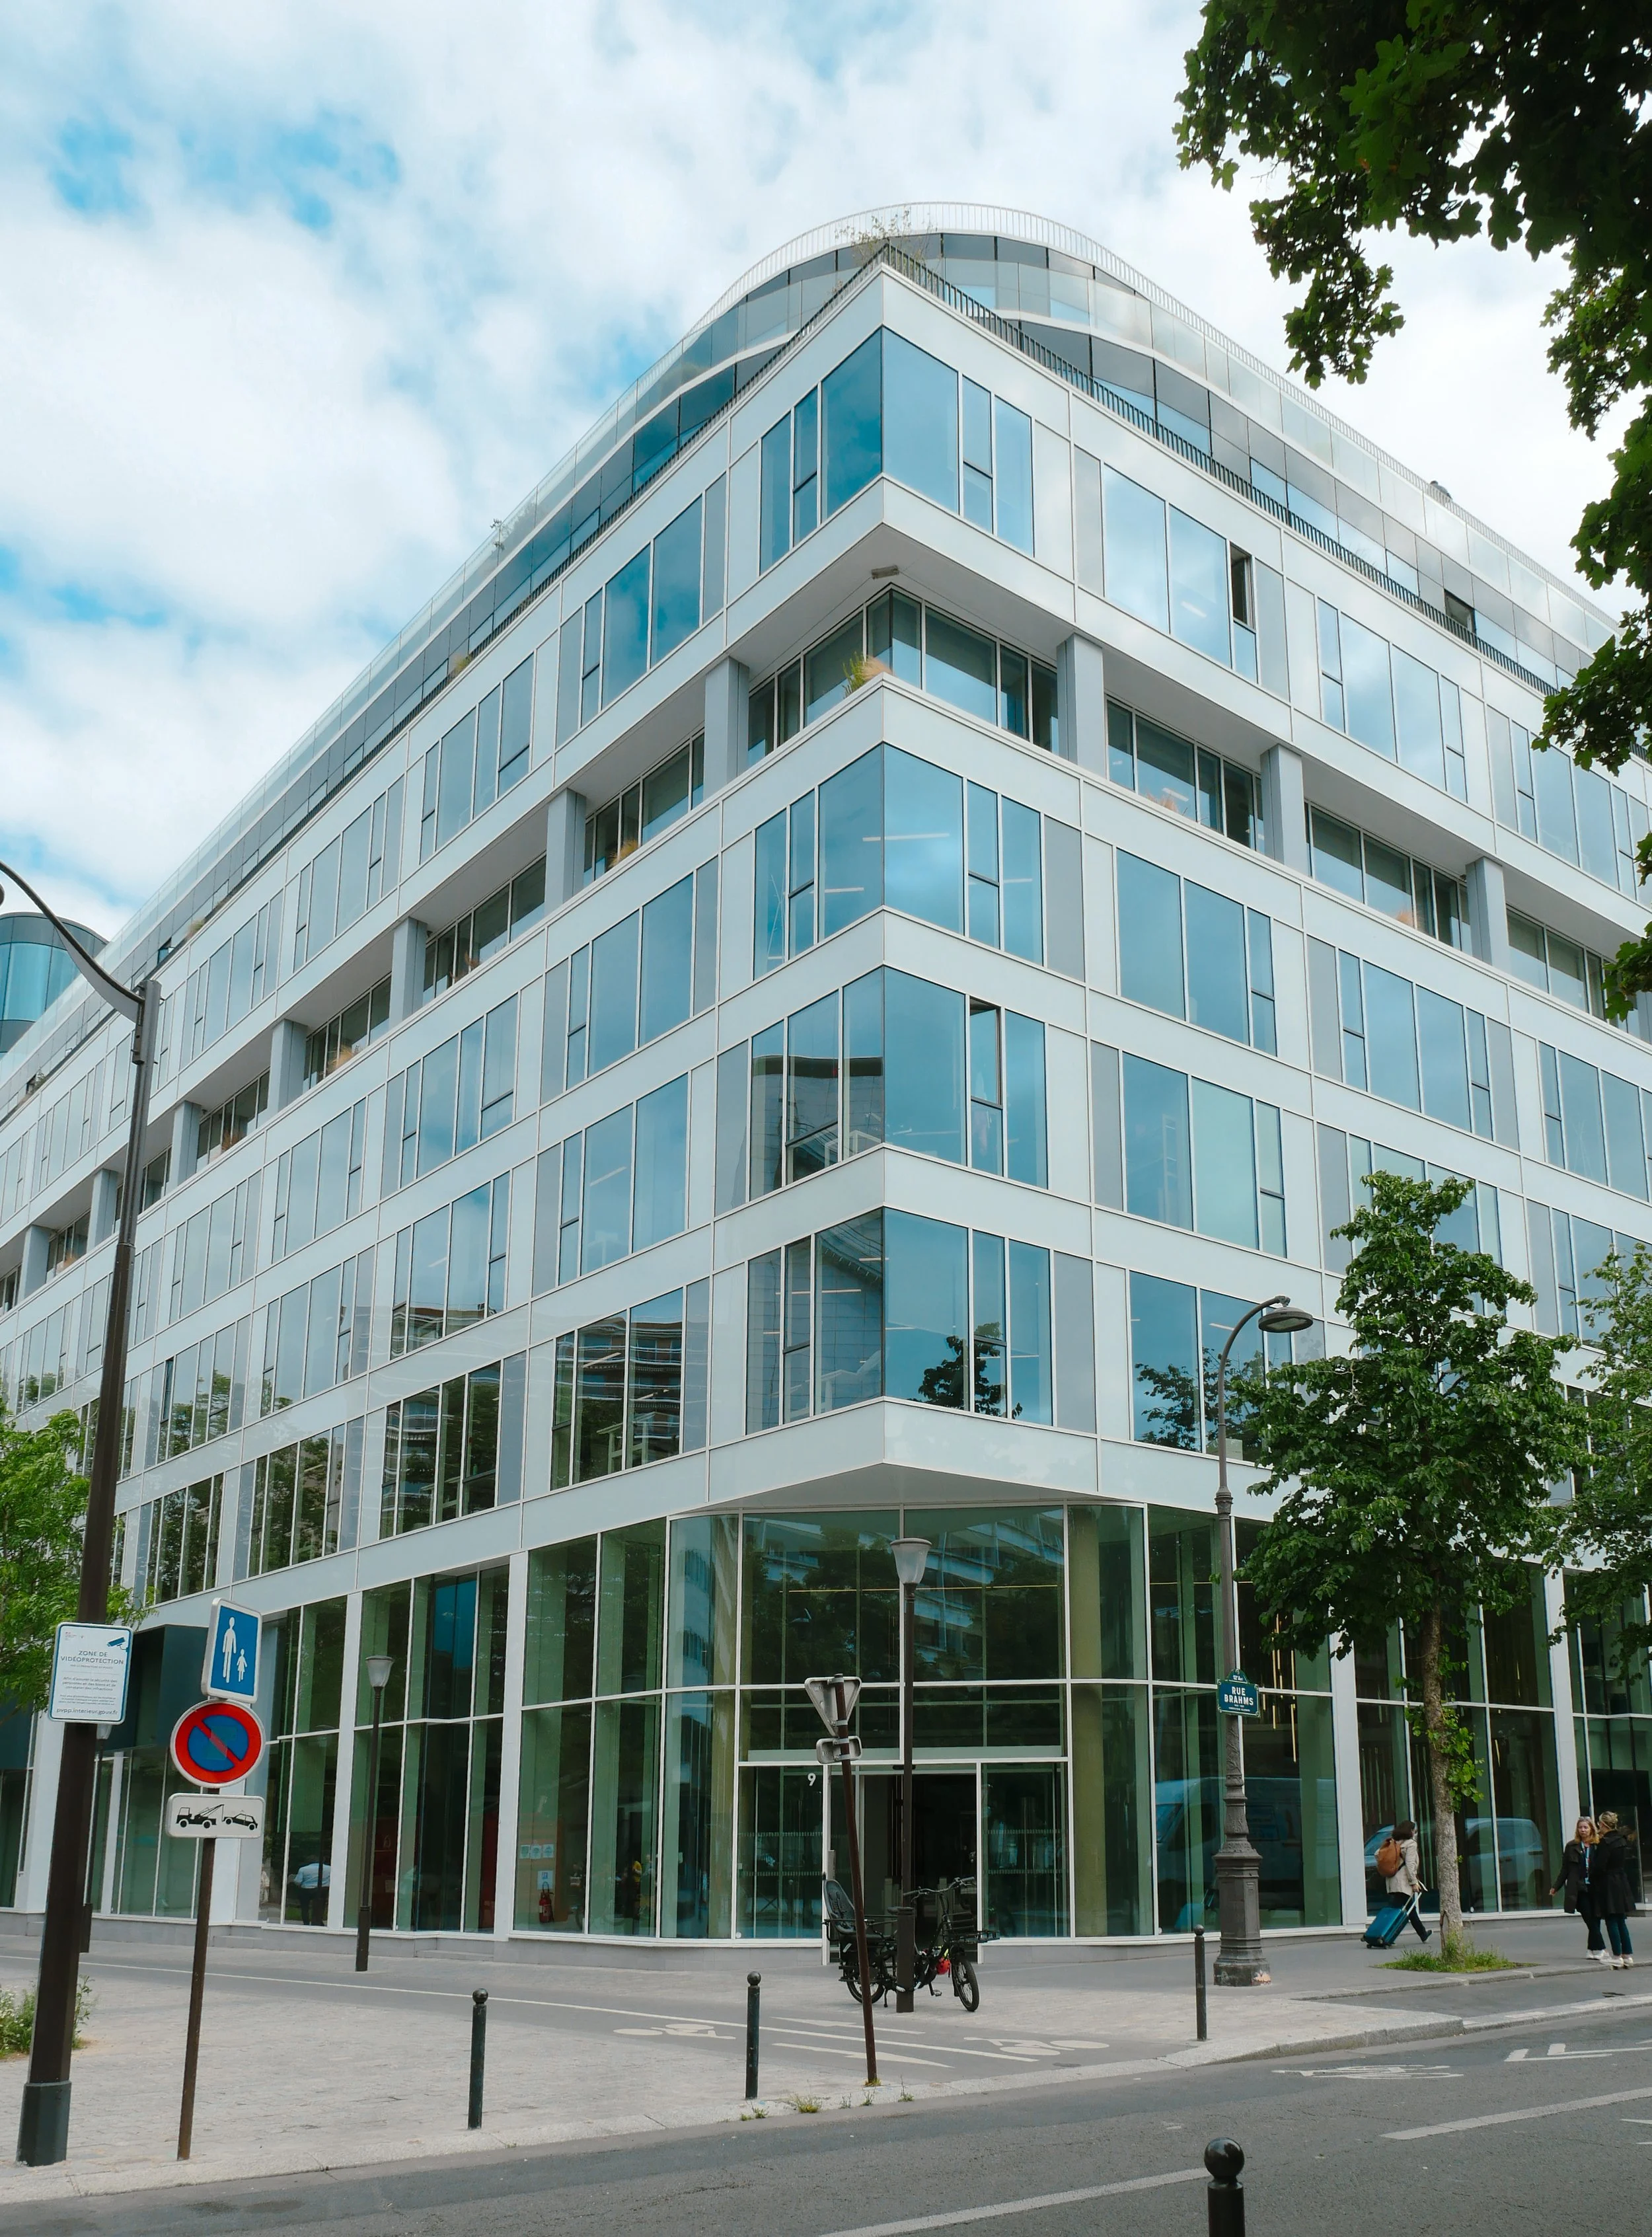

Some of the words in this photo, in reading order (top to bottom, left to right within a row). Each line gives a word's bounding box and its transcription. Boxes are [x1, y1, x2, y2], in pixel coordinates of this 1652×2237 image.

[61, 1656, 124, 1665] VIDÉOPROTECTION
[1232, 1686, 1246, 1696] RUE
[1224, 1694, 1254, 1706] BRAHMS
[807, 1772, 816, 1787] 9
